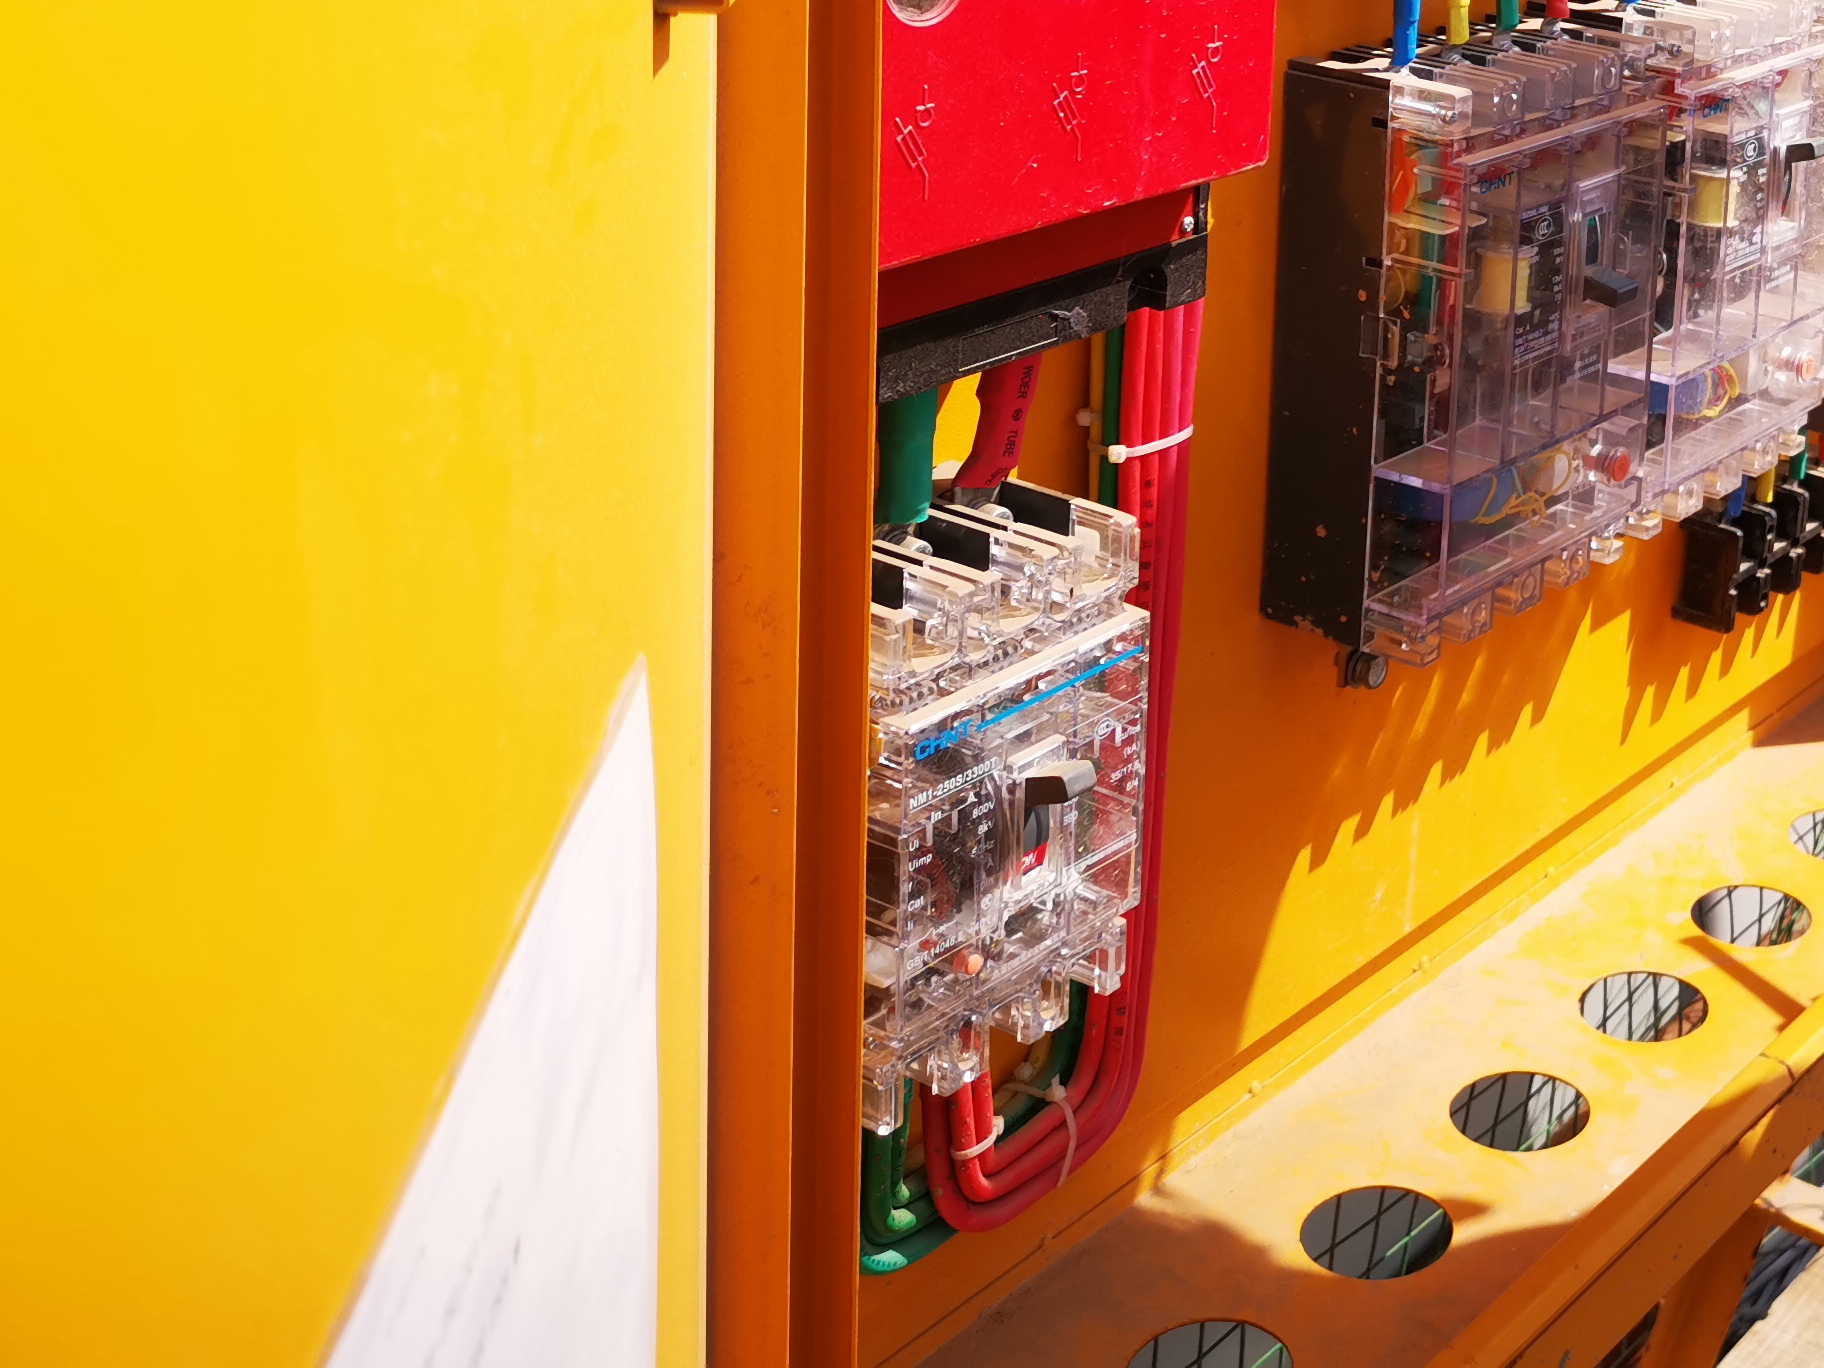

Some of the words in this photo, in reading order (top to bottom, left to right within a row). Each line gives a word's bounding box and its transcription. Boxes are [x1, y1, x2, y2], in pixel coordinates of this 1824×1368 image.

[1479, 170, 1515, 195] CHNT
[1016, 364, 1035, 400] WOER
[1002, 429, 1019, 459] TUBE
[914, 719, 975, 762] CHNT
[908, 853, 934, 872] Uimp
